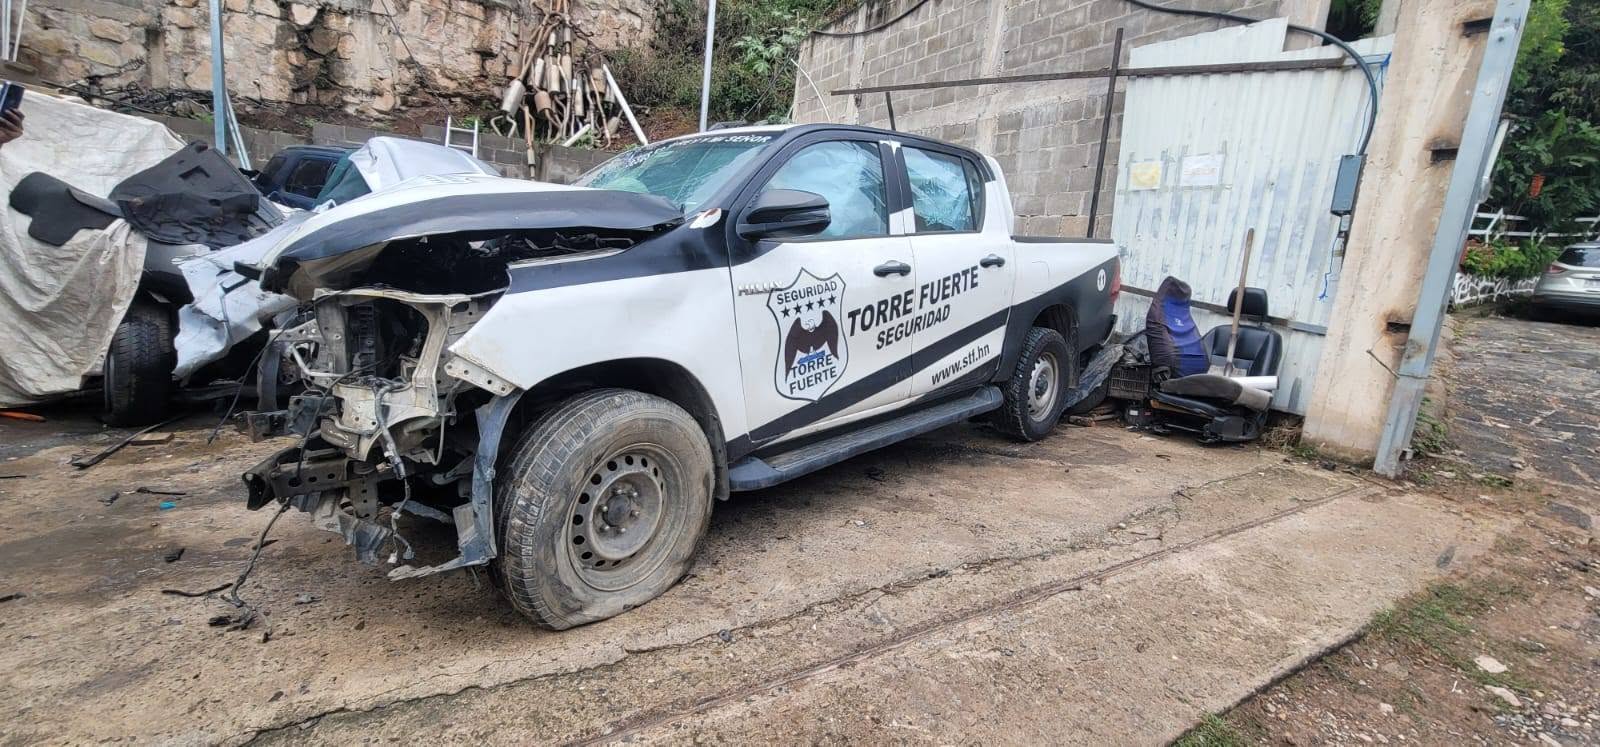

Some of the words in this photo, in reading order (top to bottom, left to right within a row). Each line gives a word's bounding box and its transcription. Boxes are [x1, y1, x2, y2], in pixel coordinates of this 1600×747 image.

[725, 134, 772, 143] SEÑOR
[776, 281, 838, 305] SEGURIDAD
[847, 290, 913, 337] TORRE
[919, 265, 979, 310] FUERTE
[875, 304, 950, 350] SEGURIDAD
[791, 354, 834, 379] TORRE
[930, 344, 990, 386] www.stf.hn
[789, 366, 838, 395] FUERTE
